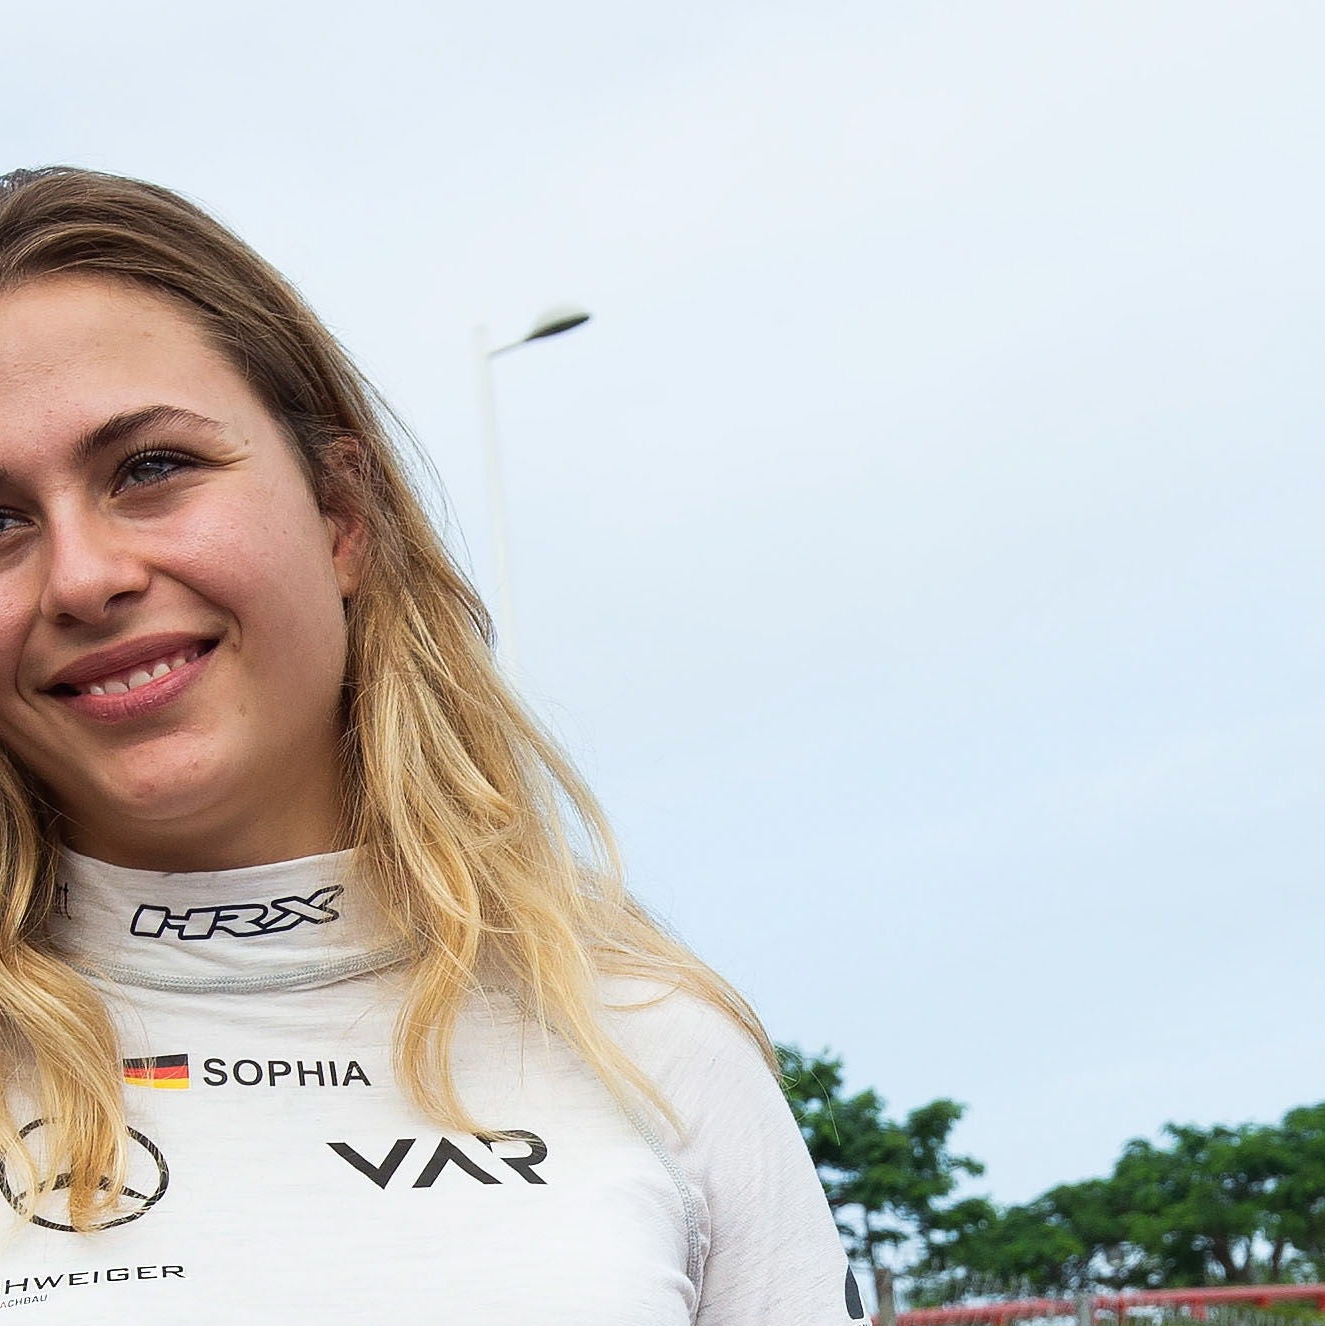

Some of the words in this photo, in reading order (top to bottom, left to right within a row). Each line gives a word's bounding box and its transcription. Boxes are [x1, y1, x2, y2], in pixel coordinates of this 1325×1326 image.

[130, 884, 344, 941] HRX
[202, 1057, 372, 1089] SOPHIA
[325, 1129, 549, 1189] VAR
